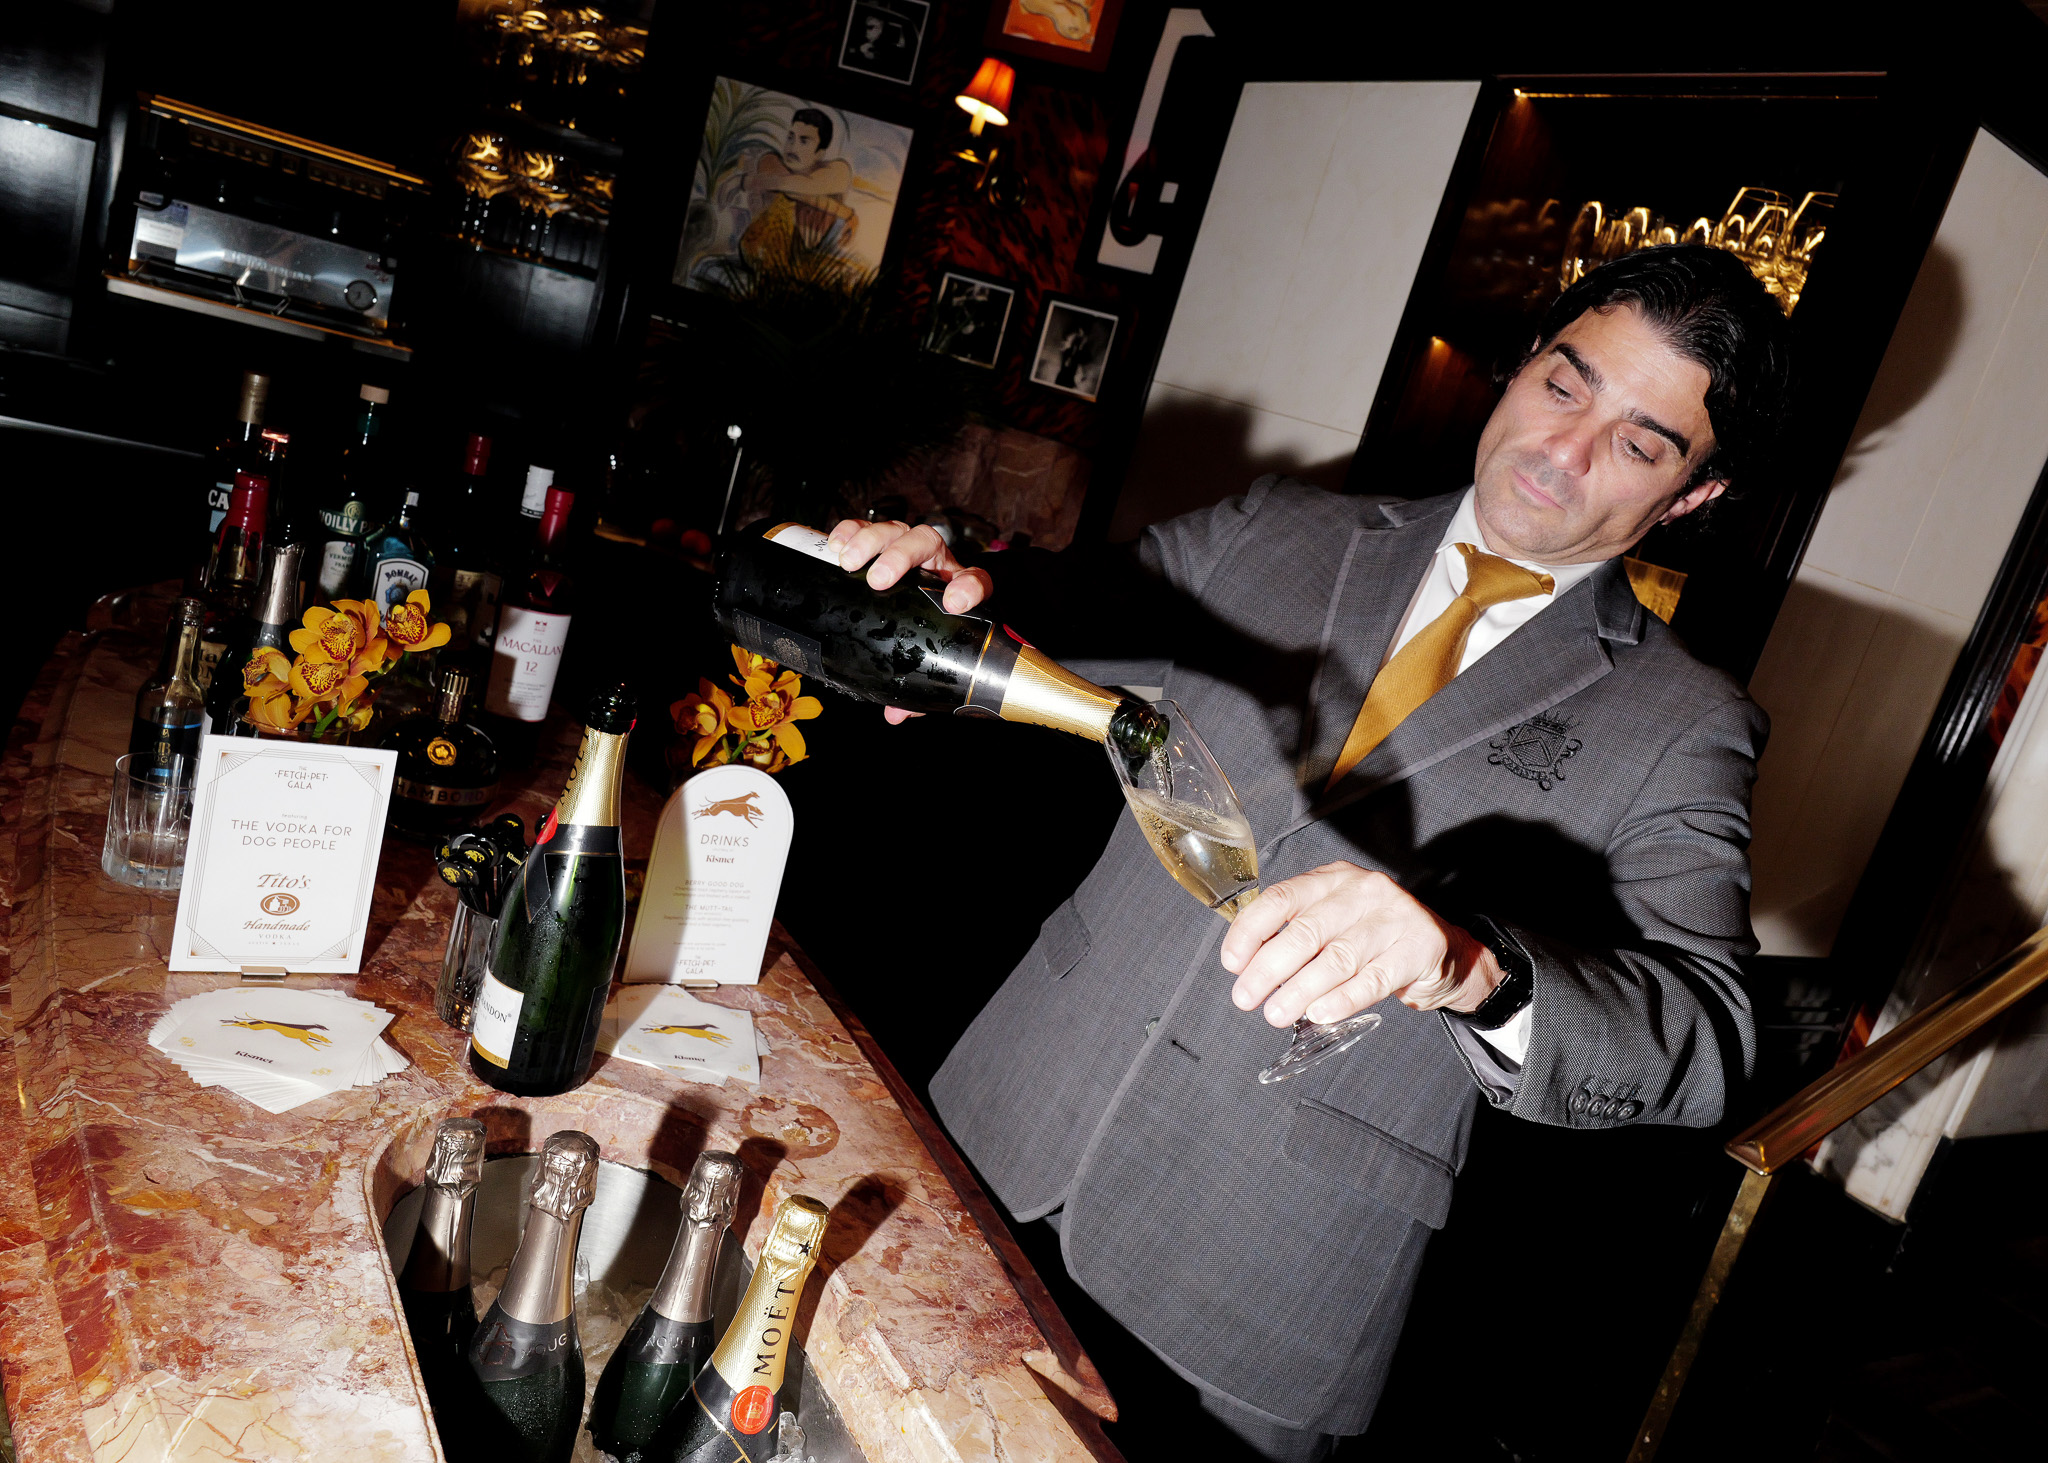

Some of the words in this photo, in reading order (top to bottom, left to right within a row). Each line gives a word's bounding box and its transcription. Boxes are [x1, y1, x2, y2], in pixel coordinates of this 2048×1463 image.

[385, 569, 418, 585] BOMBAY
[526, 661, 538, 673] 12
[287, 780, 313, 790] GALA
[231, 819, 259, 831] THE
[266, 821, 318, 834] VODKA
[324, 825, 352, 836] FOR
[242, 835, 276, 847] DOG
[283, 838, 337, 851] PEOPLE
[700, 834, 750, 848] DRINKS
[706, 854, 735, 864] Kismet
[257, 872, 311, 889] Tito's
[242, 918, 311, 931] Handmade
[235, 1050, 274, 1064] Kismet
[753, 1281, 796, 1376] MOËT
